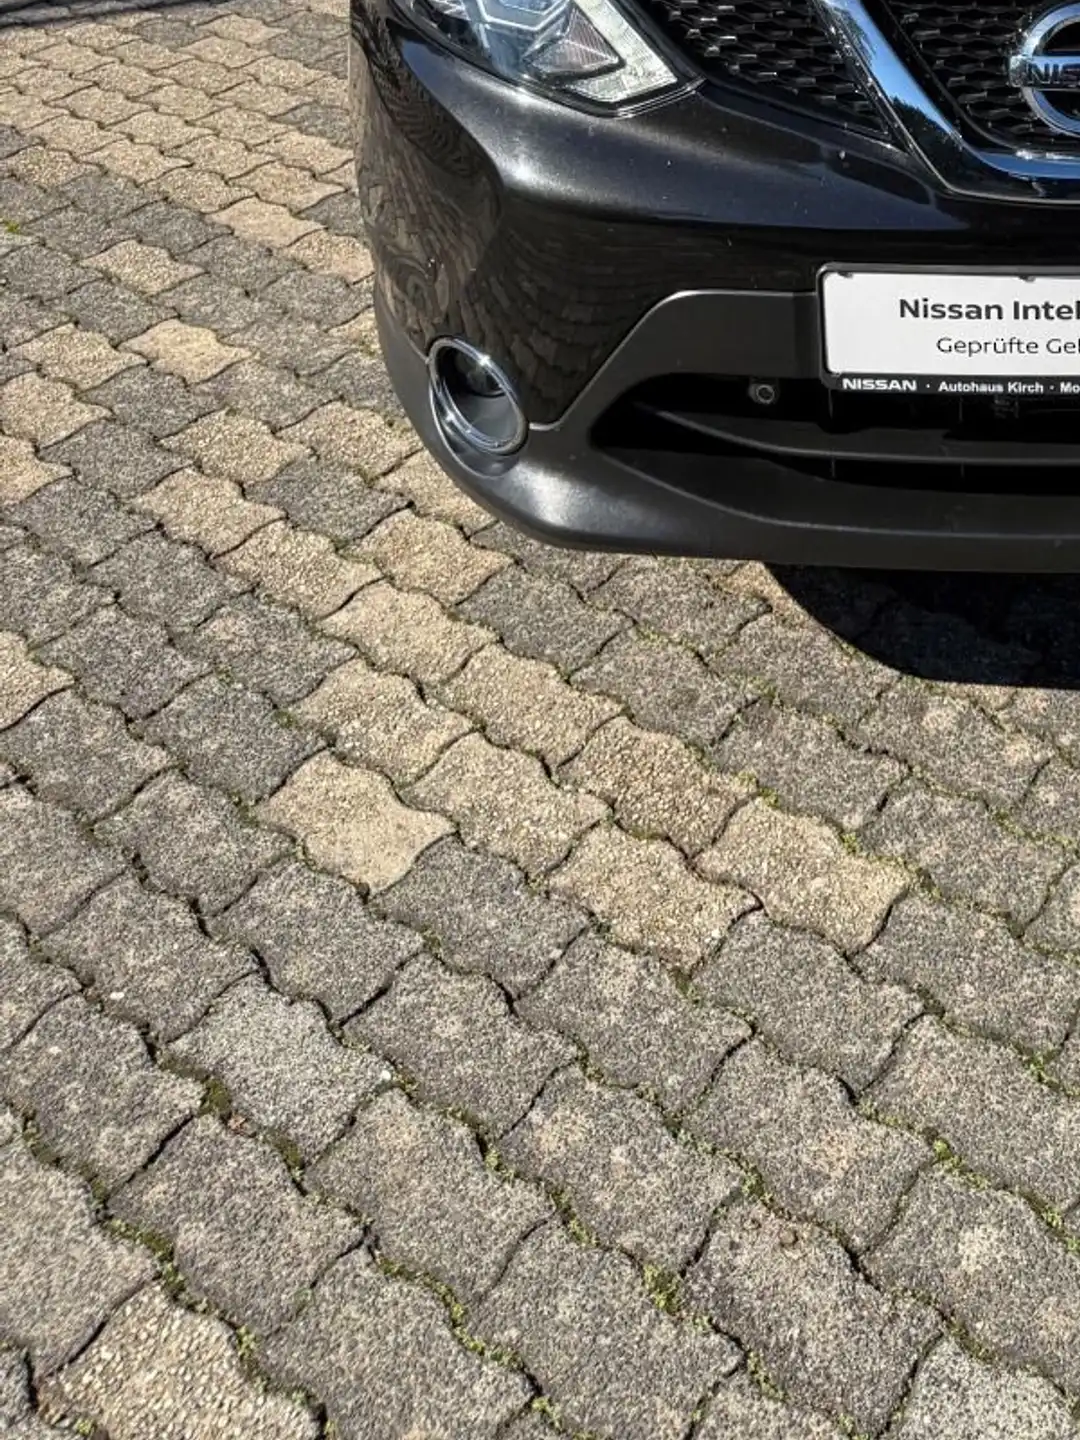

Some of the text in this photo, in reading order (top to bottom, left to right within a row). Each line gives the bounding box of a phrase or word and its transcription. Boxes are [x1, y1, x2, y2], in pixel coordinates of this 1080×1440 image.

[899, 298, 1003, 320] Nissan
[936, 336, 1040, 357] Geprüfte
[842, 378, 917, 391] NISSAN
[938, 381, 1004, 393] Autohaus
[1008, 381, 1044, 394] Kirch
